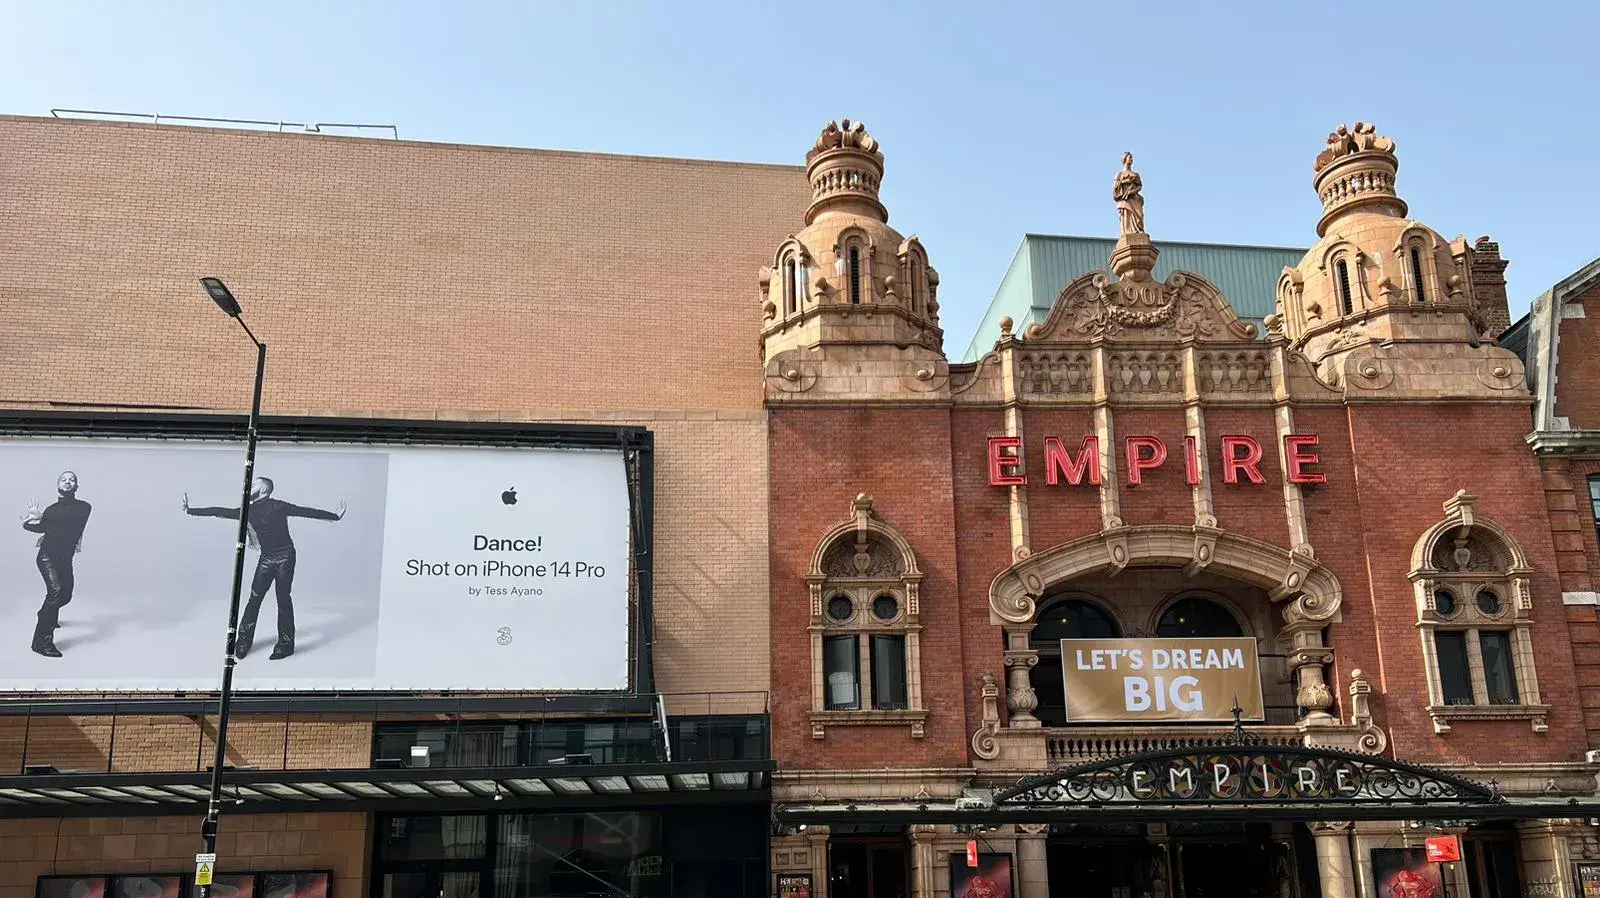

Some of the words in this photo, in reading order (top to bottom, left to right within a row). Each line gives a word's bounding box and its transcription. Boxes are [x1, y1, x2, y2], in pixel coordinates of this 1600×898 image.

[1117, 286, 1164, 305] 1901
[987, 436, 1326, 486] EMPIRE
[474, 535, 542, 551] Dance!
[406, 559, 450, 576] Shot
[454, 563, 478, 577] on
[482, 560, 547, 577] iPhone
[550, 561, 571, 578] 14
[575, 561, 606, 578] Pro
[468, 586, 482, 597] by
[485, 586, 508, 596] Tess
[510, 587, 543, 598] Ayano
[1076, 649, 1144, 670] LET'S
[1152, 648, 1245, 669] DREAM
[1123, 675, 1204, 712] BIG
[1133, 764, 1355, 792] EMPIRE
